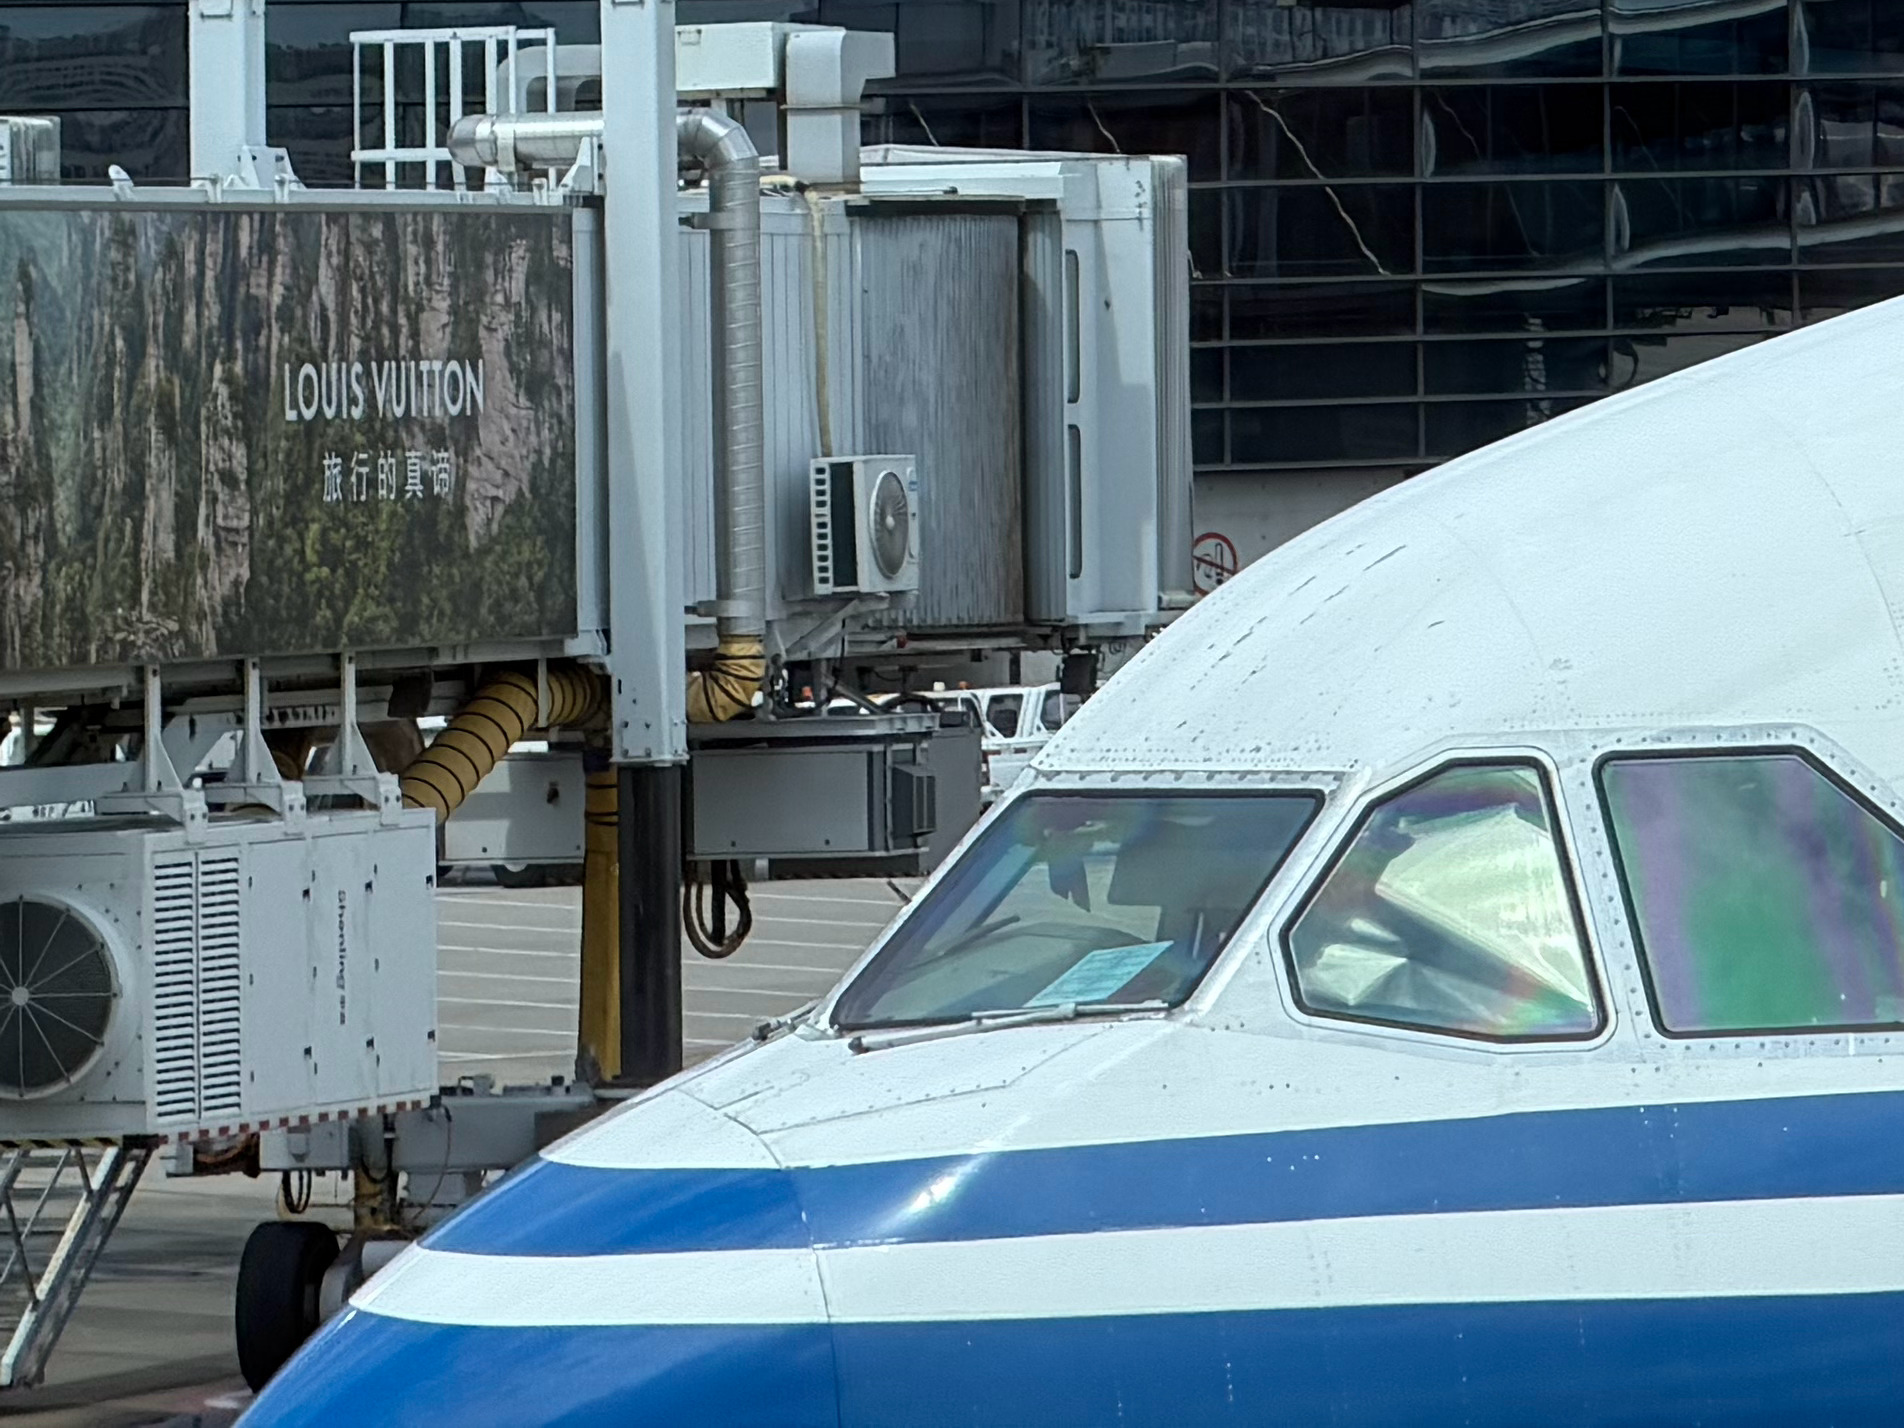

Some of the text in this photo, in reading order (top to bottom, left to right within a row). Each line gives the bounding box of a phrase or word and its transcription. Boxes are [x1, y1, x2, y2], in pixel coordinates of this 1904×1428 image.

[284, 358, 485, 421] LOUIS VUITTON
[322, 449, 450, 502] 旅行的真谛
